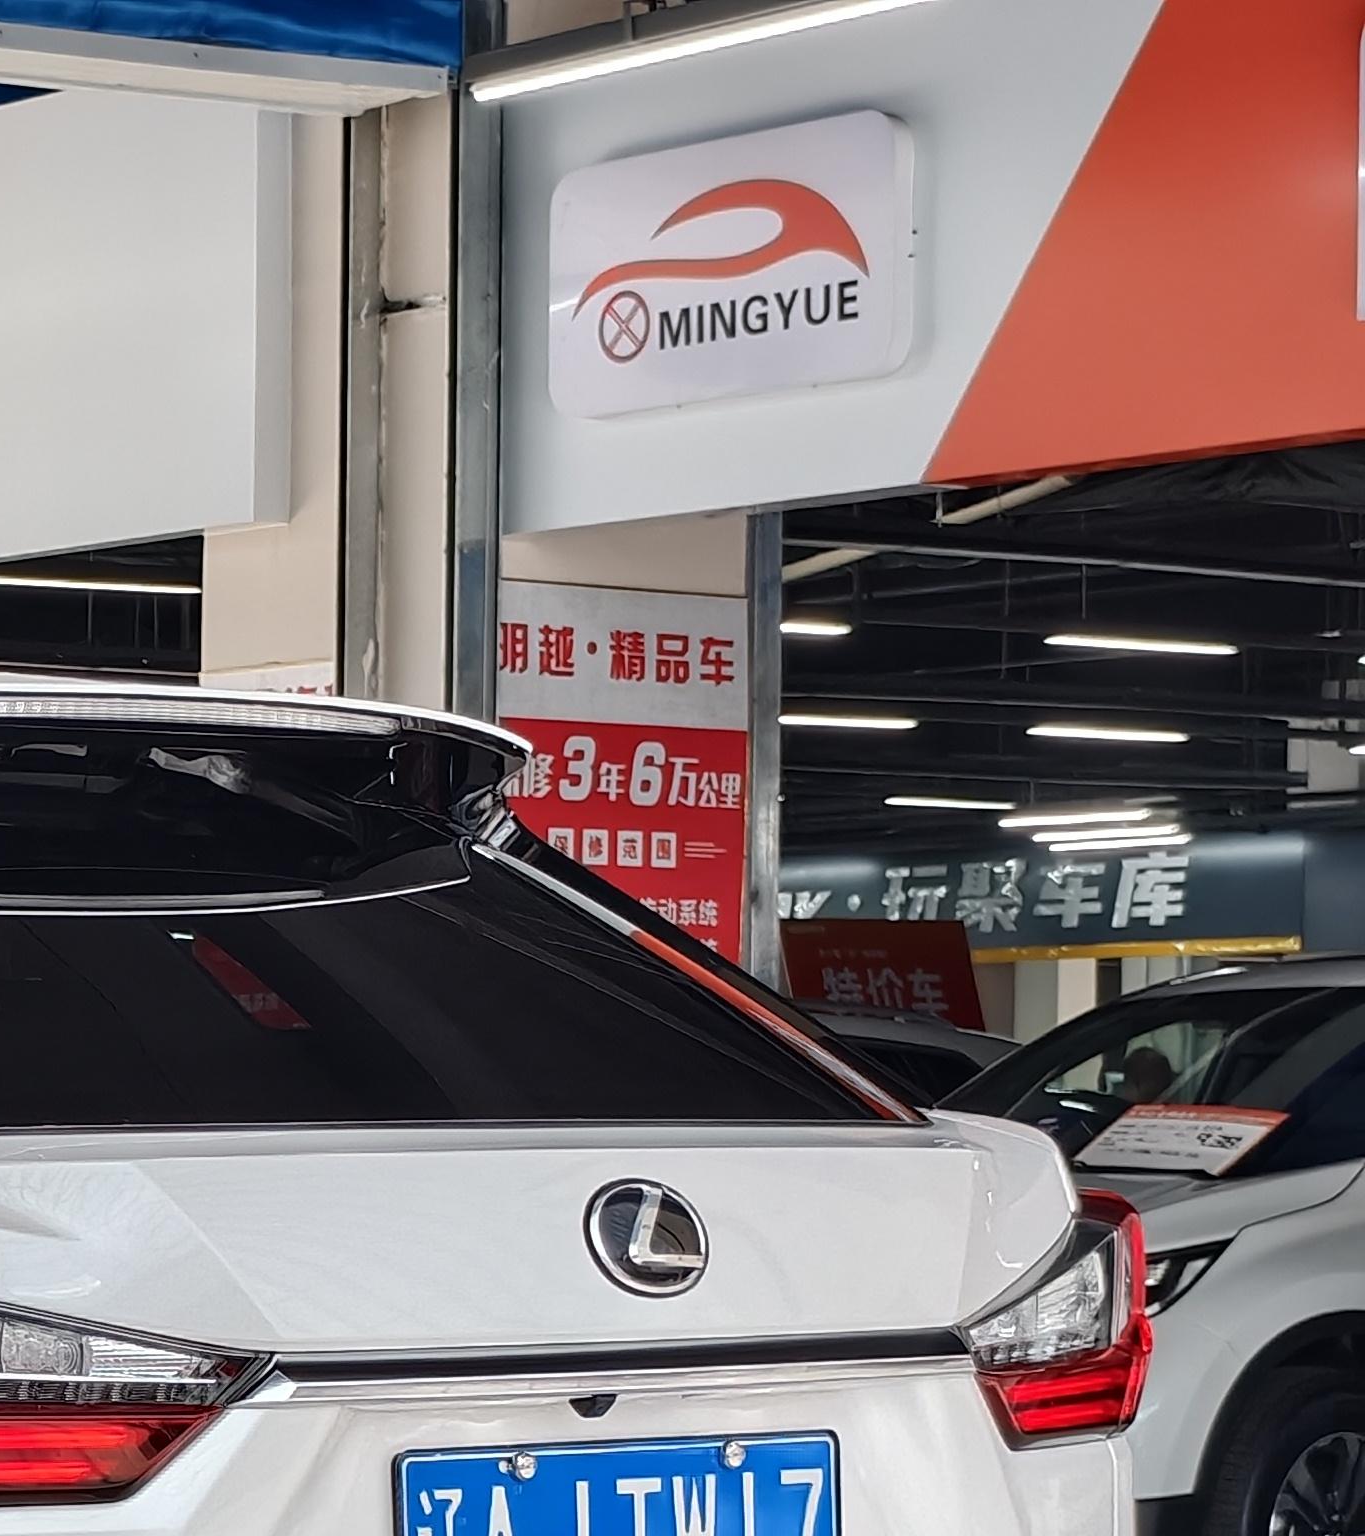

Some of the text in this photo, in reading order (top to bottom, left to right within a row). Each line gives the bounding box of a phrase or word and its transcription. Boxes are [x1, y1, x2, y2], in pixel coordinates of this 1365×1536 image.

[658, 279, 859, 351] MINGYUE
[504, 735, 742, 810] 修3年6万公里
